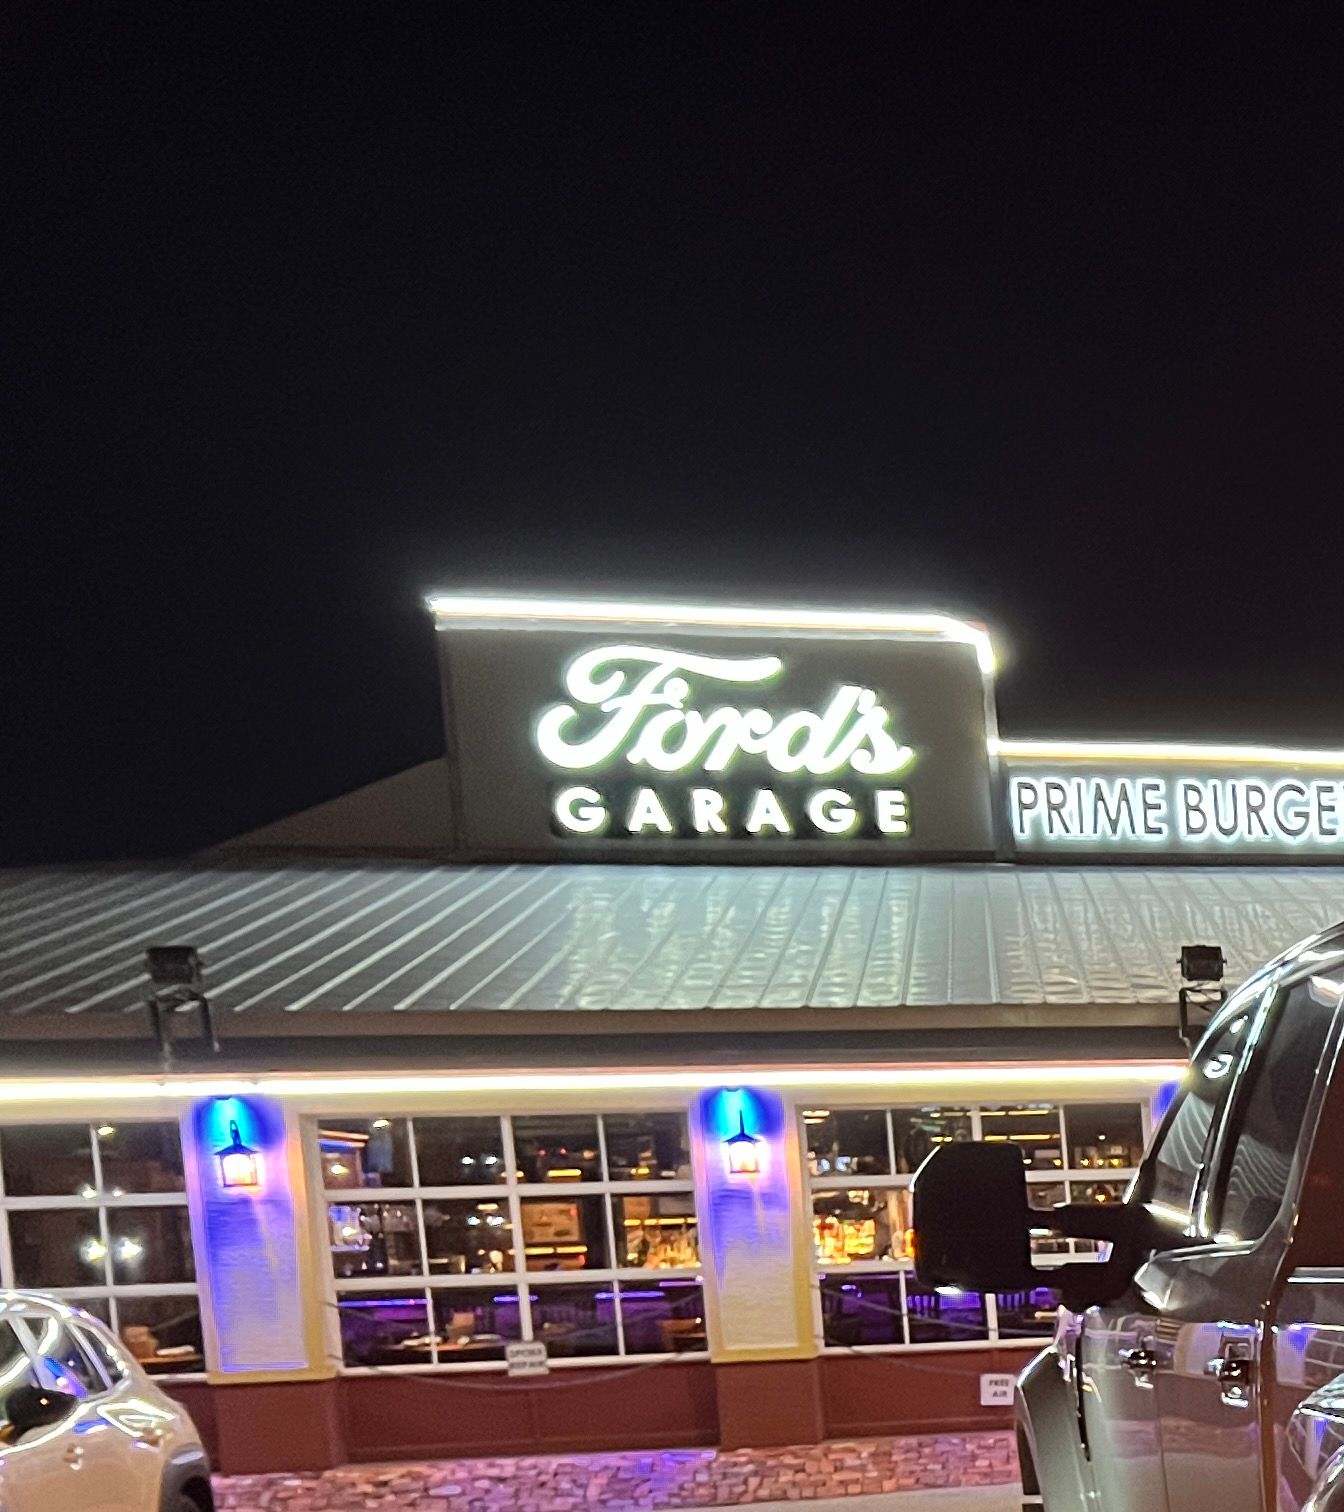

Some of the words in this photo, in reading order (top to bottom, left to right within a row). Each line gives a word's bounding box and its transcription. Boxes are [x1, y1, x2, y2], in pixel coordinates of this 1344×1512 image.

[537, 645, 914, 774] Ford's
[555, 786, 910, 834] GARAGE
[1010, 779, 1168, 838] PRIME
